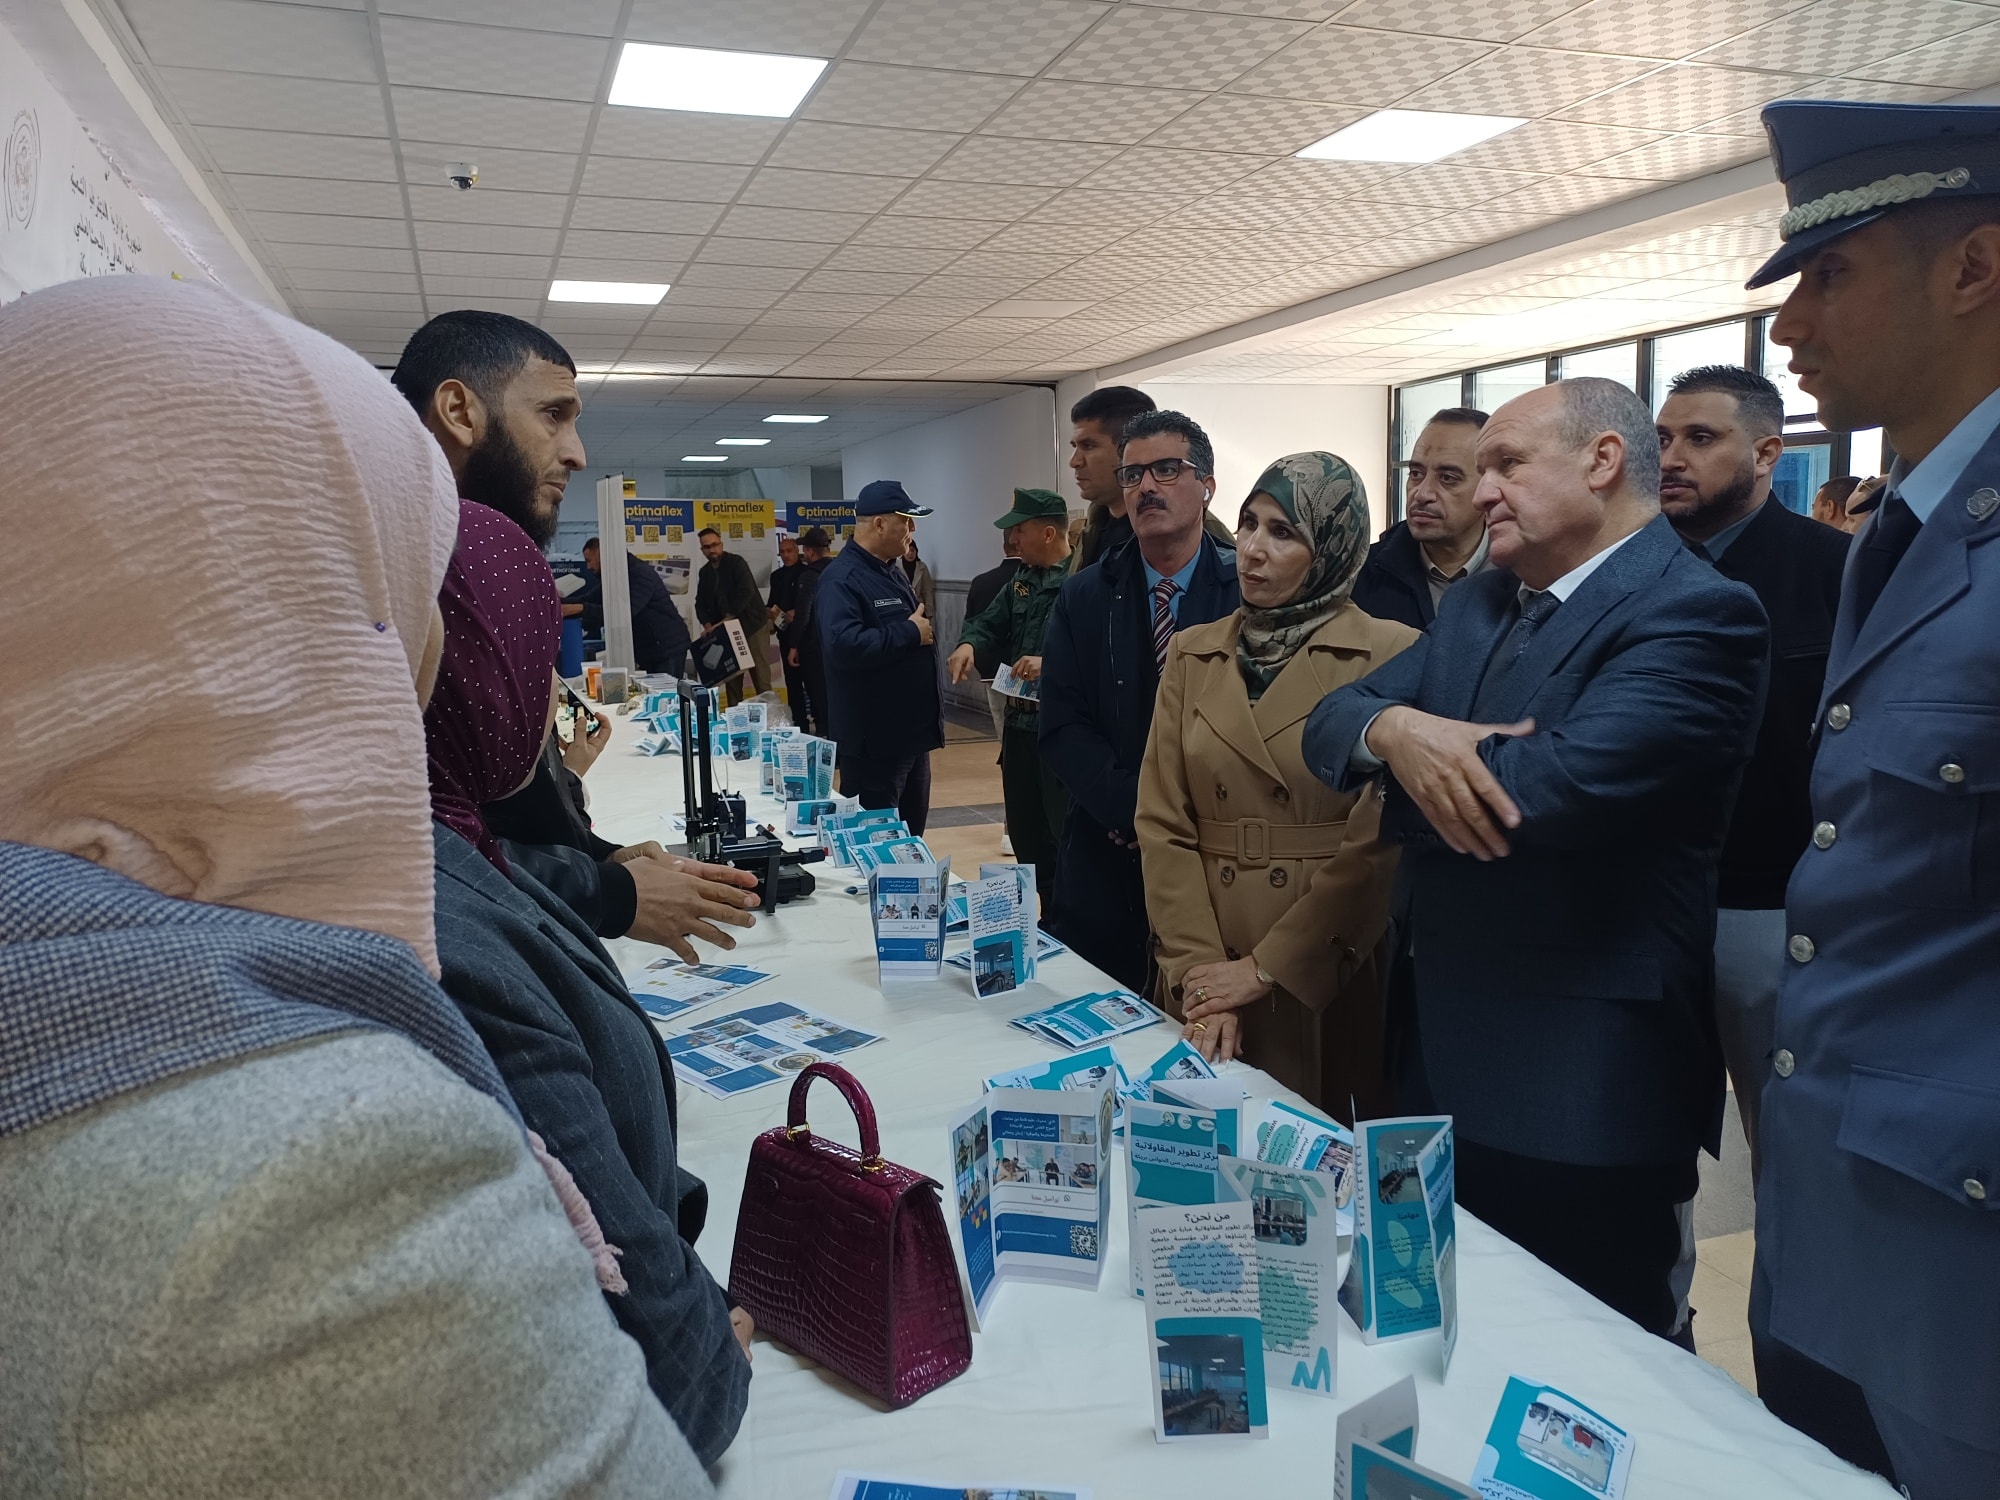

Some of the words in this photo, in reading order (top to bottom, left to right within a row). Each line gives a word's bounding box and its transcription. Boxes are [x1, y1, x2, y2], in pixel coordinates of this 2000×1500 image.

[625, 505, 683, 519] ptimaflex
[703, 502, 764, 515] Optimaflex
[1135, 1140, 1176, 1153] المقاولاتية
[1256, 1119, 1278, 1161] www.cde.d
[1177, 1149, 1201, 1158] تطوير
[1184, 1212, 1211, 1224] نحن؟
[1214, 1213, 1230, 1223] من
